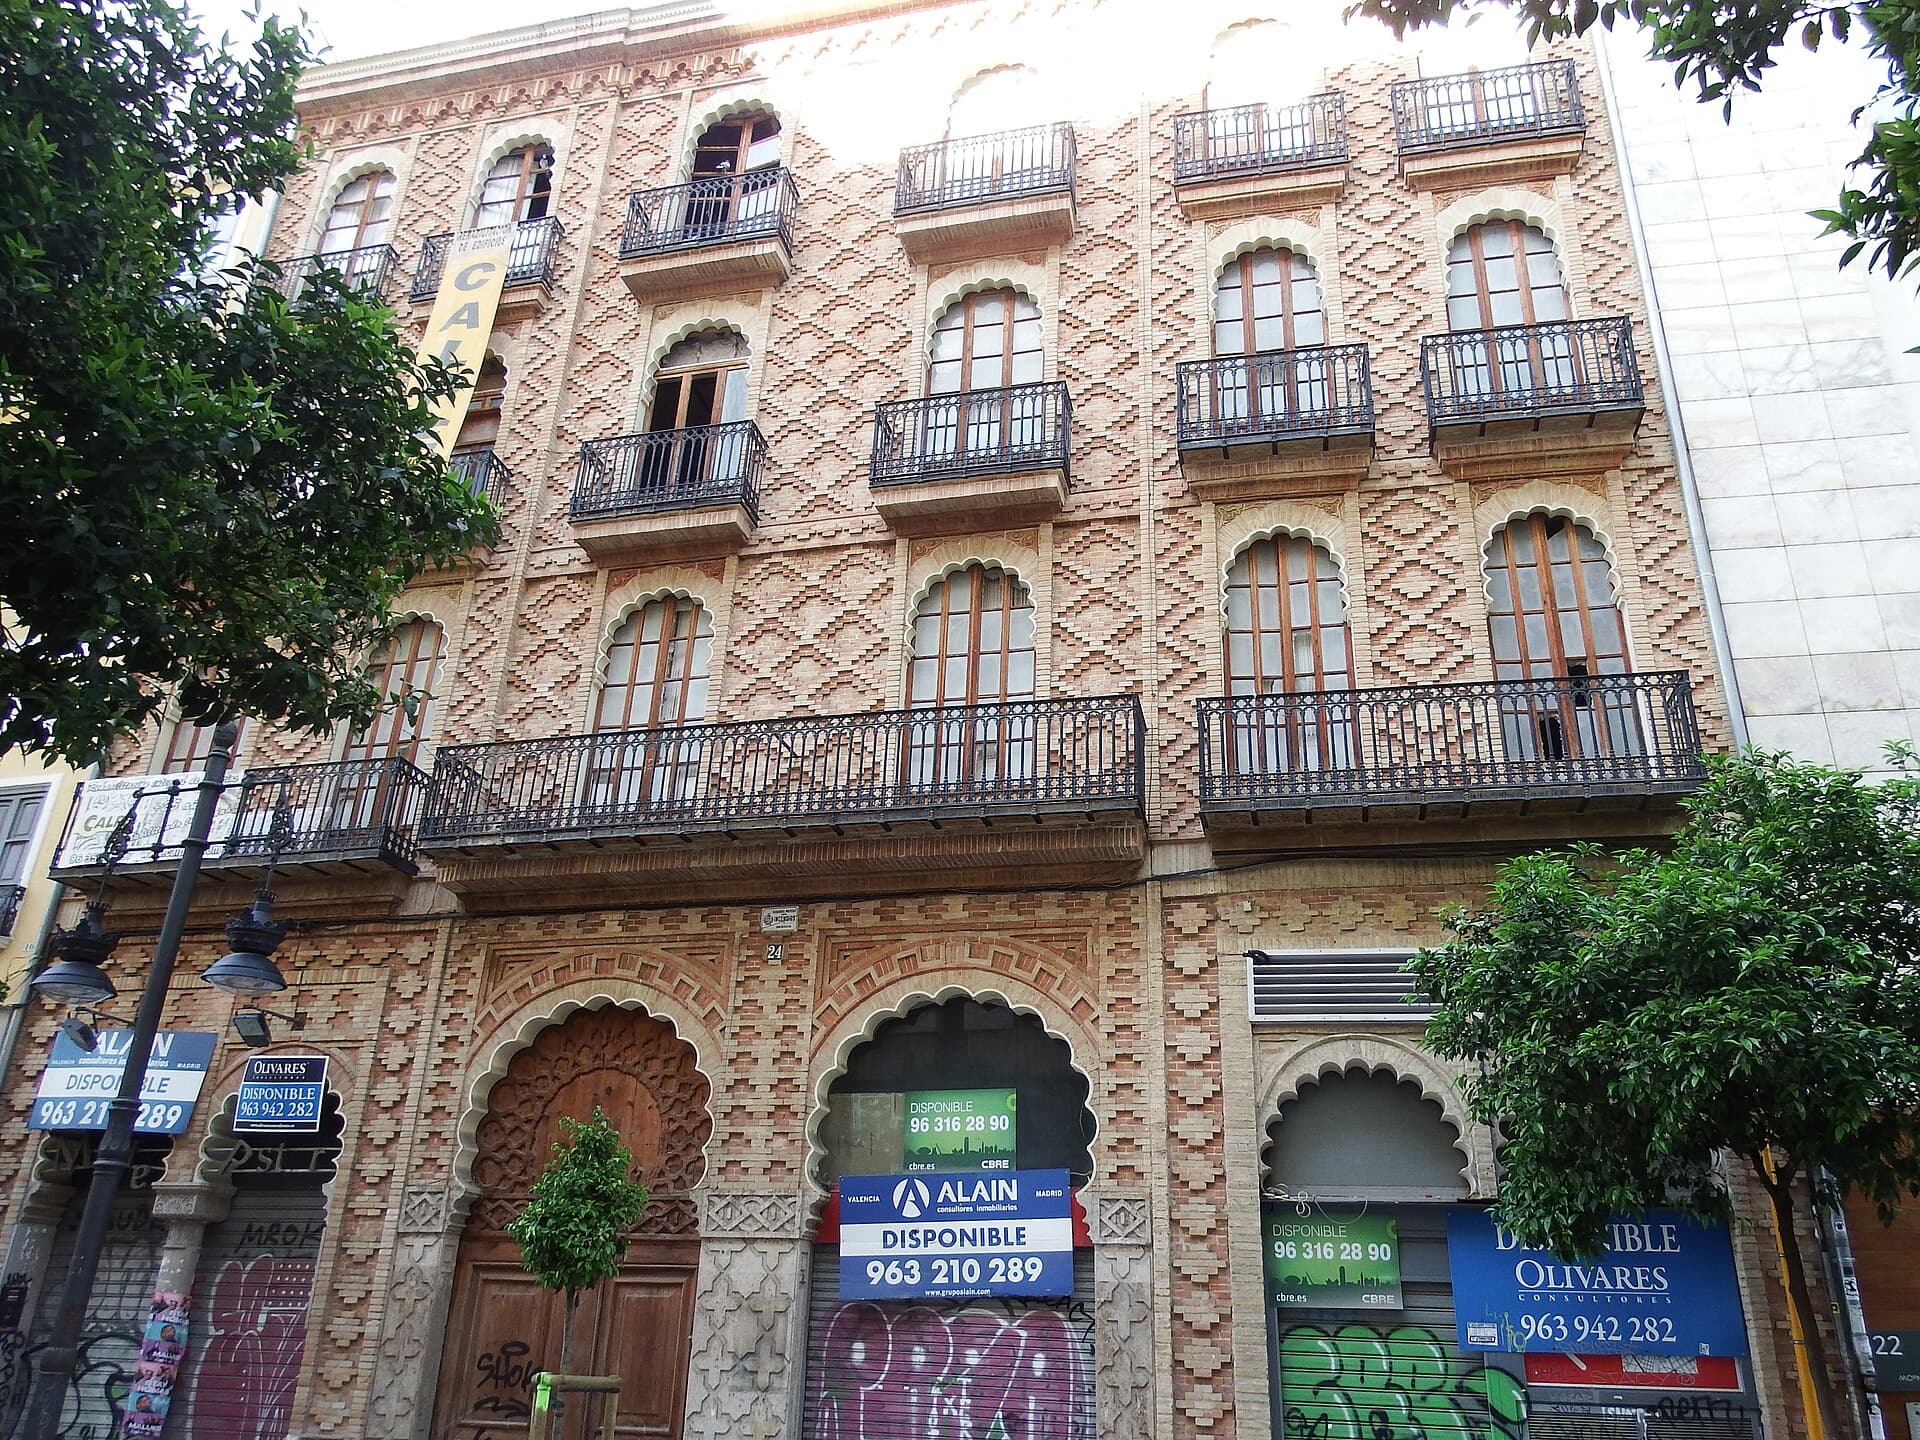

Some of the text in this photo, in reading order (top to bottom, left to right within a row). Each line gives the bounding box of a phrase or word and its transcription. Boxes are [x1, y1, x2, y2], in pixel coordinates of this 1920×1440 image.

[767, 945, 782, 959] 24
[254, 1060, 307, 1074] OLIVARES
[243, 1087, 316, 1100] DISPONIBLE
[240, 1101, 314, 1117] 963 942 282
[910, 1101, 973, 1113] DISPONIBLE
[40, 1101, 76, 1125] 963
[134, 1104, 183, 1129] 289
[910, 1114, 1009, 1133] 96 316 28 90
[909, 1162, 935, 1171] cbre.es
[981, 1159, 1009, 1169] CBRE
[936, 1179, 1018, 1203] ALAIN
[1035, 1189, 1063, 1197] MADRID
[847, 1195, 880, 1203] VALENCIA
[937, 1203, 1018, 1213] consultores inmobiliarios
[882, 1226, 1027, 1249] DISPONIBLE
[1272, 1224, 1348, 1238] DISPONIBLE
[1274, 1241, 1392, 1261] 96 316 28 90
[866, 1256, 1043, 1285] 963 210 289
[1515, 1259, 1669, 1291] OLIVARES
[924, 1287, 991, 1297] www.grupoalain.com
[1276, 1292, 1307, 1303] cbre.es
[1517, 1294, 1672, 1304] CONSULTORES
[1361, 1294, 1395, 1305] CBRE
[1520, 1312, 1569, 1342] 963
[1573, 1313, 1623, 1343] 942
[1627, 1316, 1677, 1342] 282
[1872, 1335, 1903, 1356] 22
